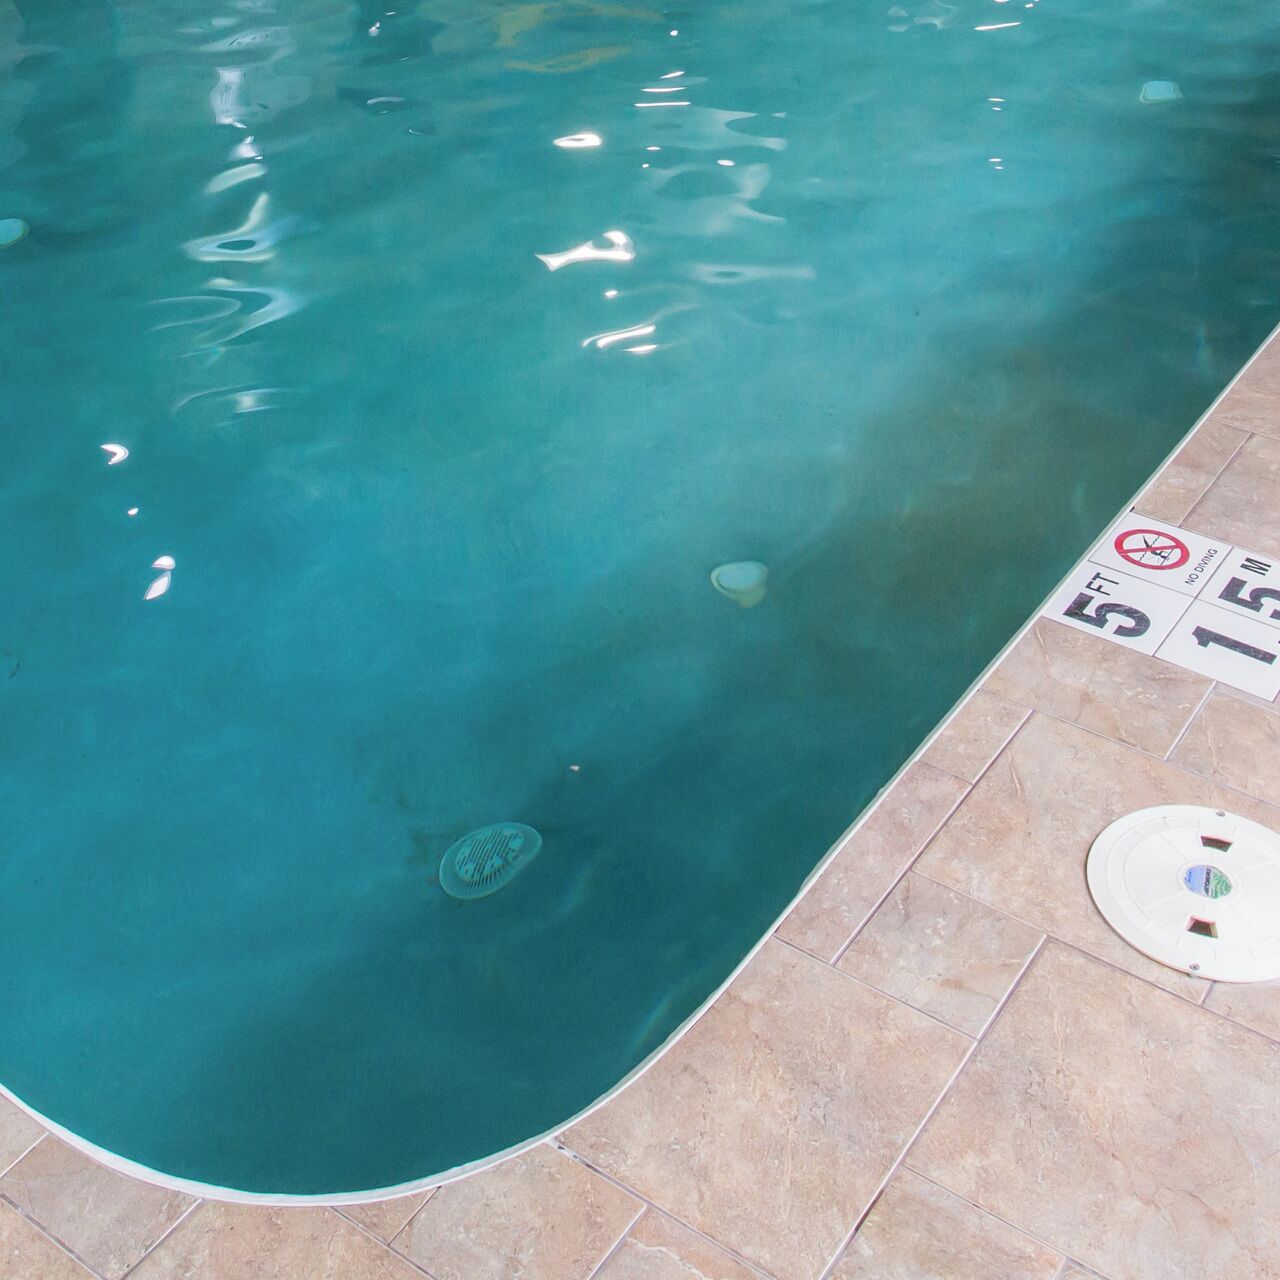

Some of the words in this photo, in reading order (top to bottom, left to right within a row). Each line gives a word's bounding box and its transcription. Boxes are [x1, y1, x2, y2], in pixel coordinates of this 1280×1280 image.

[1085, 572, 1120, 596] FT
[1184, 573, 1200, 586] NO
[1193, 548, 1218, 573] DIVING
[1062, 592, 1151, 638] 5
